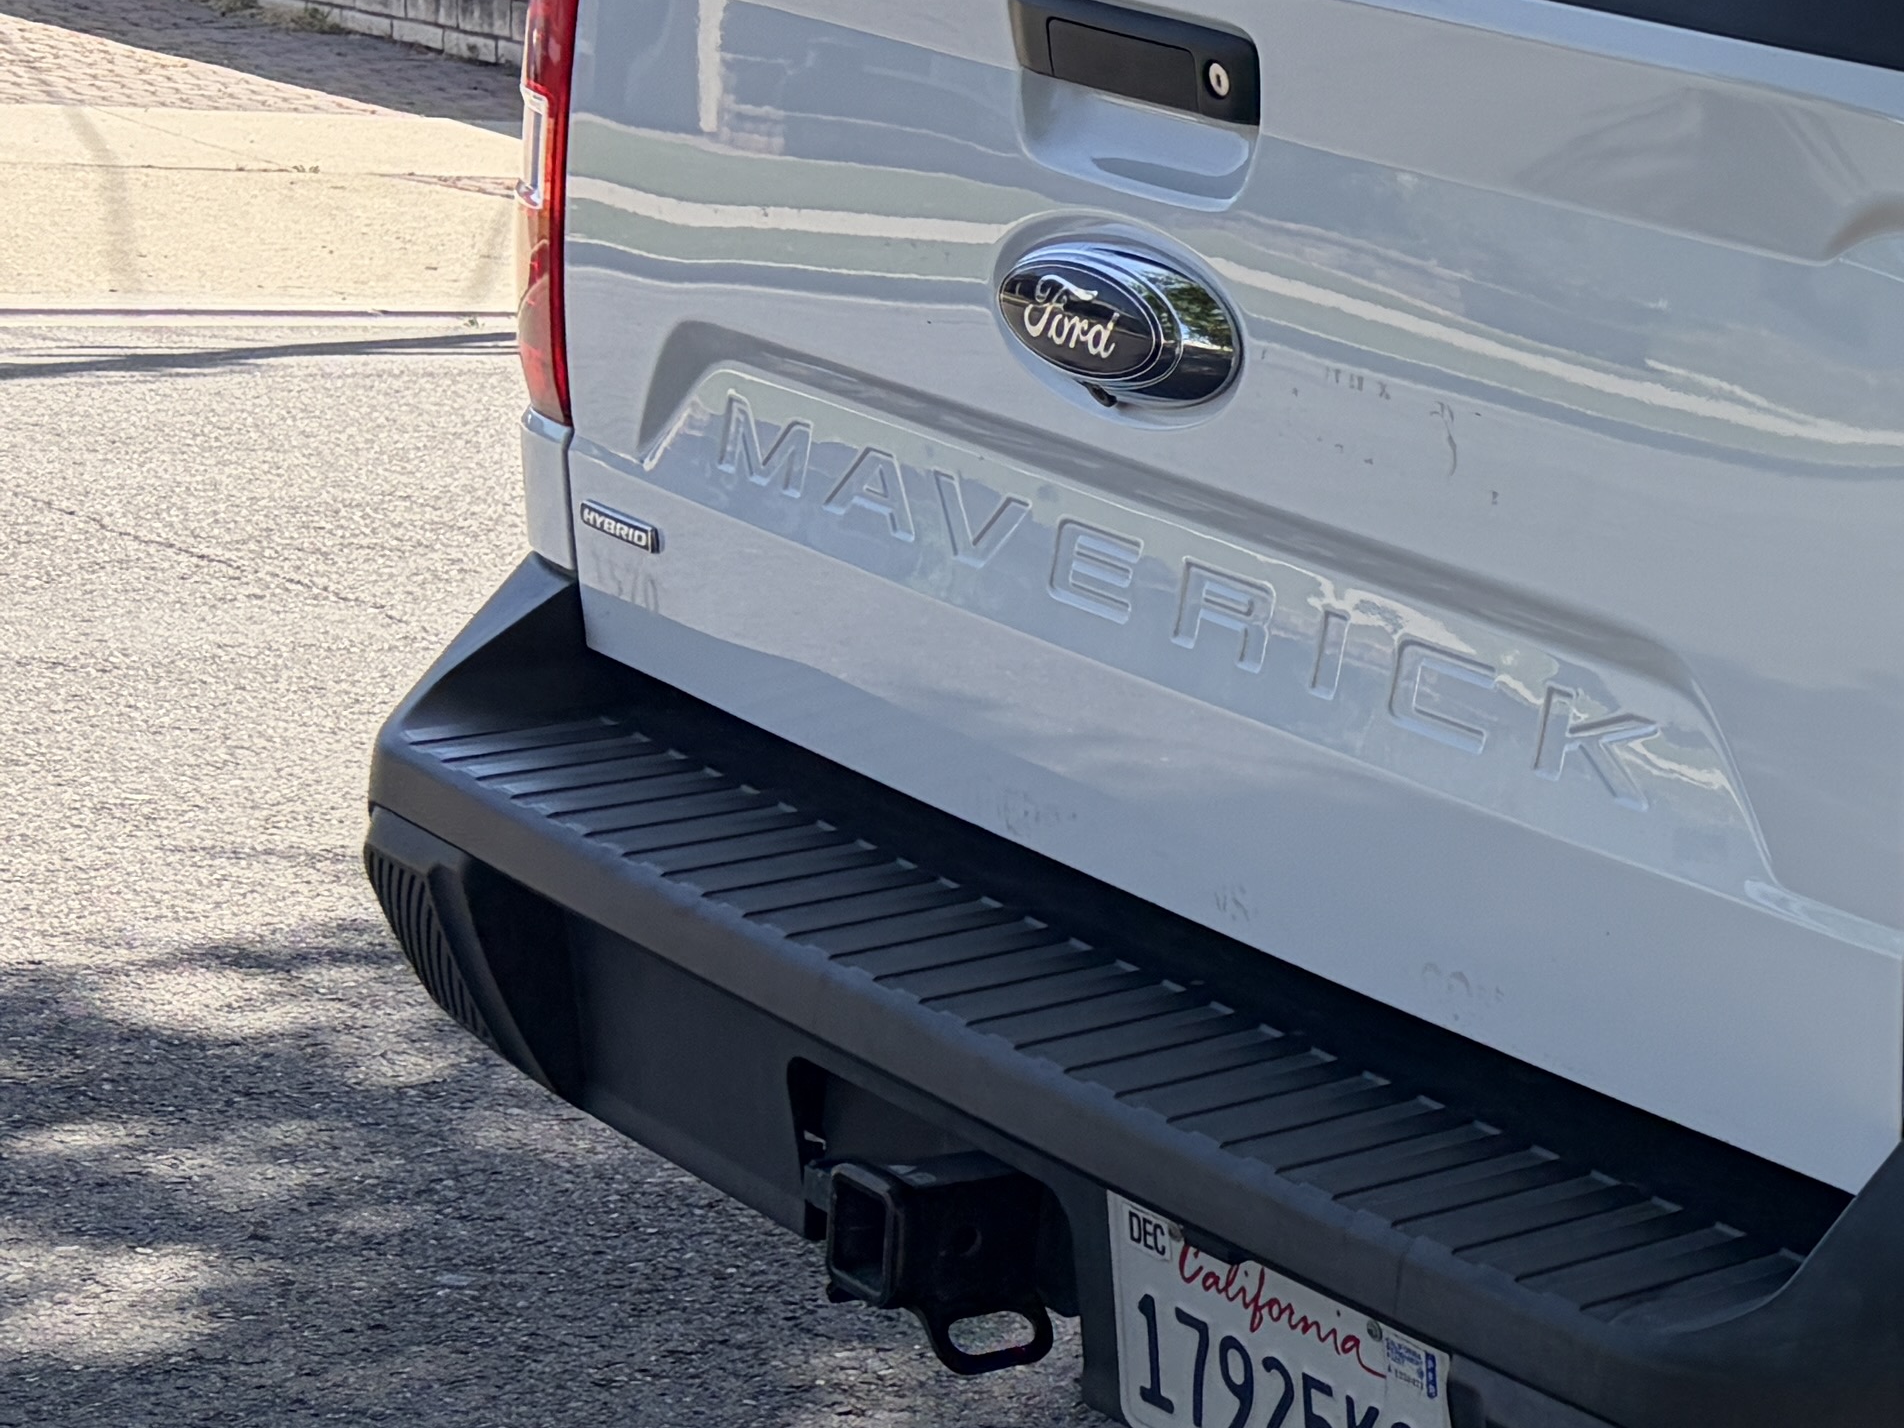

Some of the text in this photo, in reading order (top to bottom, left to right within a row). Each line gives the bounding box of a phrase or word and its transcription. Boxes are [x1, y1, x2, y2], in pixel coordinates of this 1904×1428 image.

[1023, 274, 1121, 359] Ford
[582, 507, 648, 547] HYBRID
[719, 387, 1660, 814] MAVERICK
[1127, 1209, 1167, 1257] DEC
[1178, 1241, 1387, 1379] California
